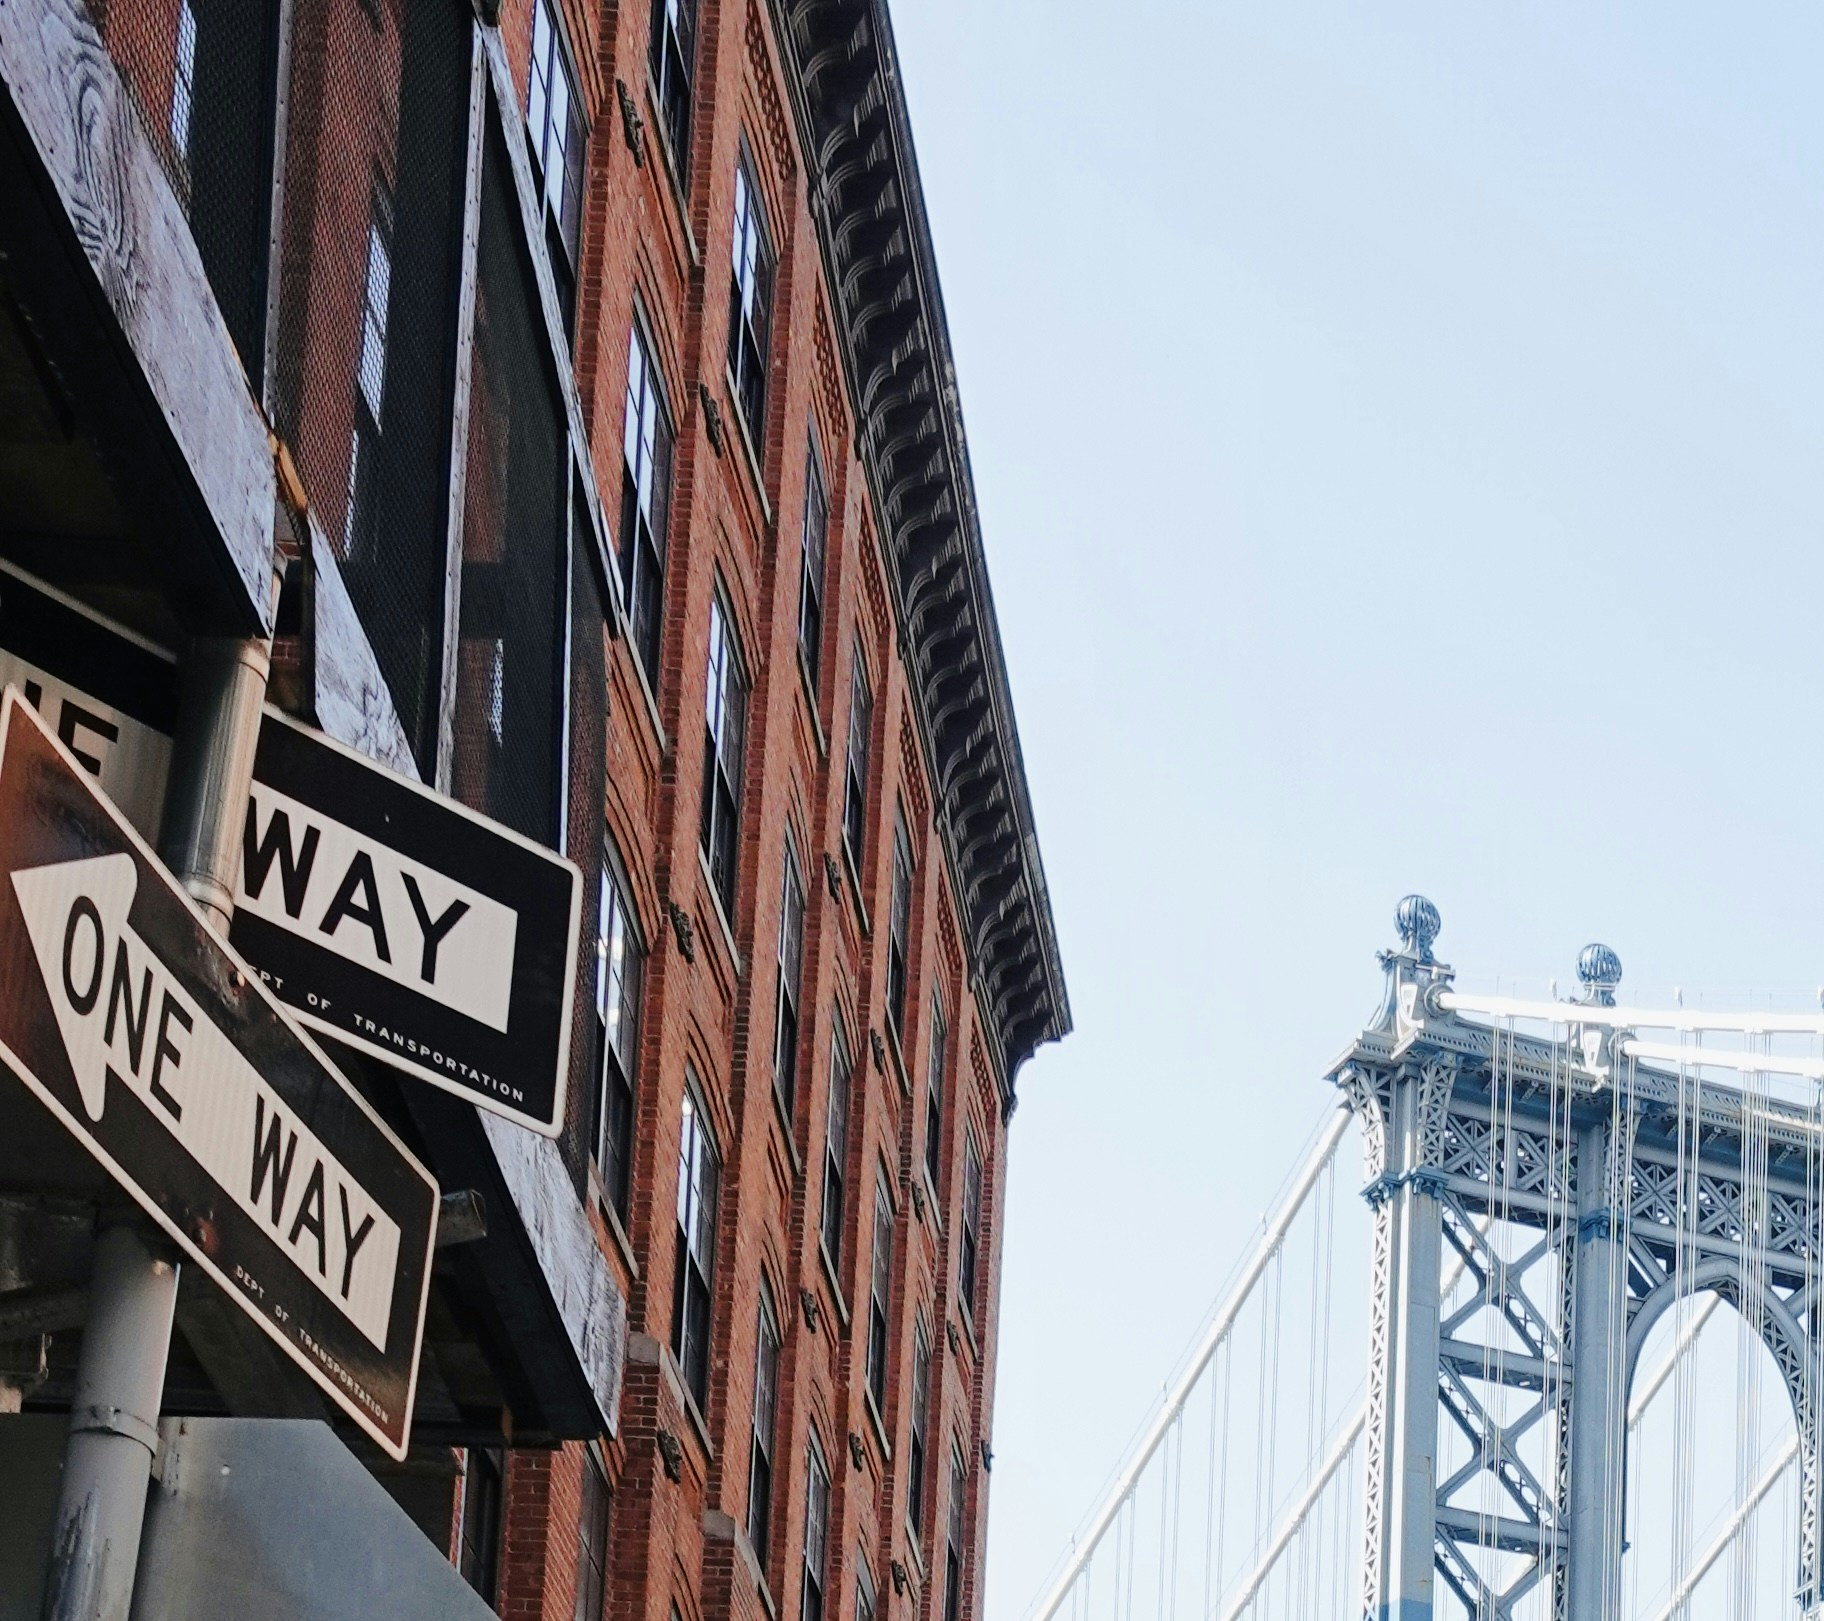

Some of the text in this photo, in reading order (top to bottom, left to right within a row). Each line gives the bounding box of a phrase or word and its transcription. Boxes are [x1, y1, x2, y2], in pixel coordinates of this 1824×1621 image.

[243, 796, 471, 985] WAY
[63, 896, 375, 1300] ONE WAY
[307, 993, 331, 1010] OF
[354, 1014, 523, 1102] TRANSPORTATION
[235, 1265, 389, 1424] DEPT OF TRANSPORTATION
